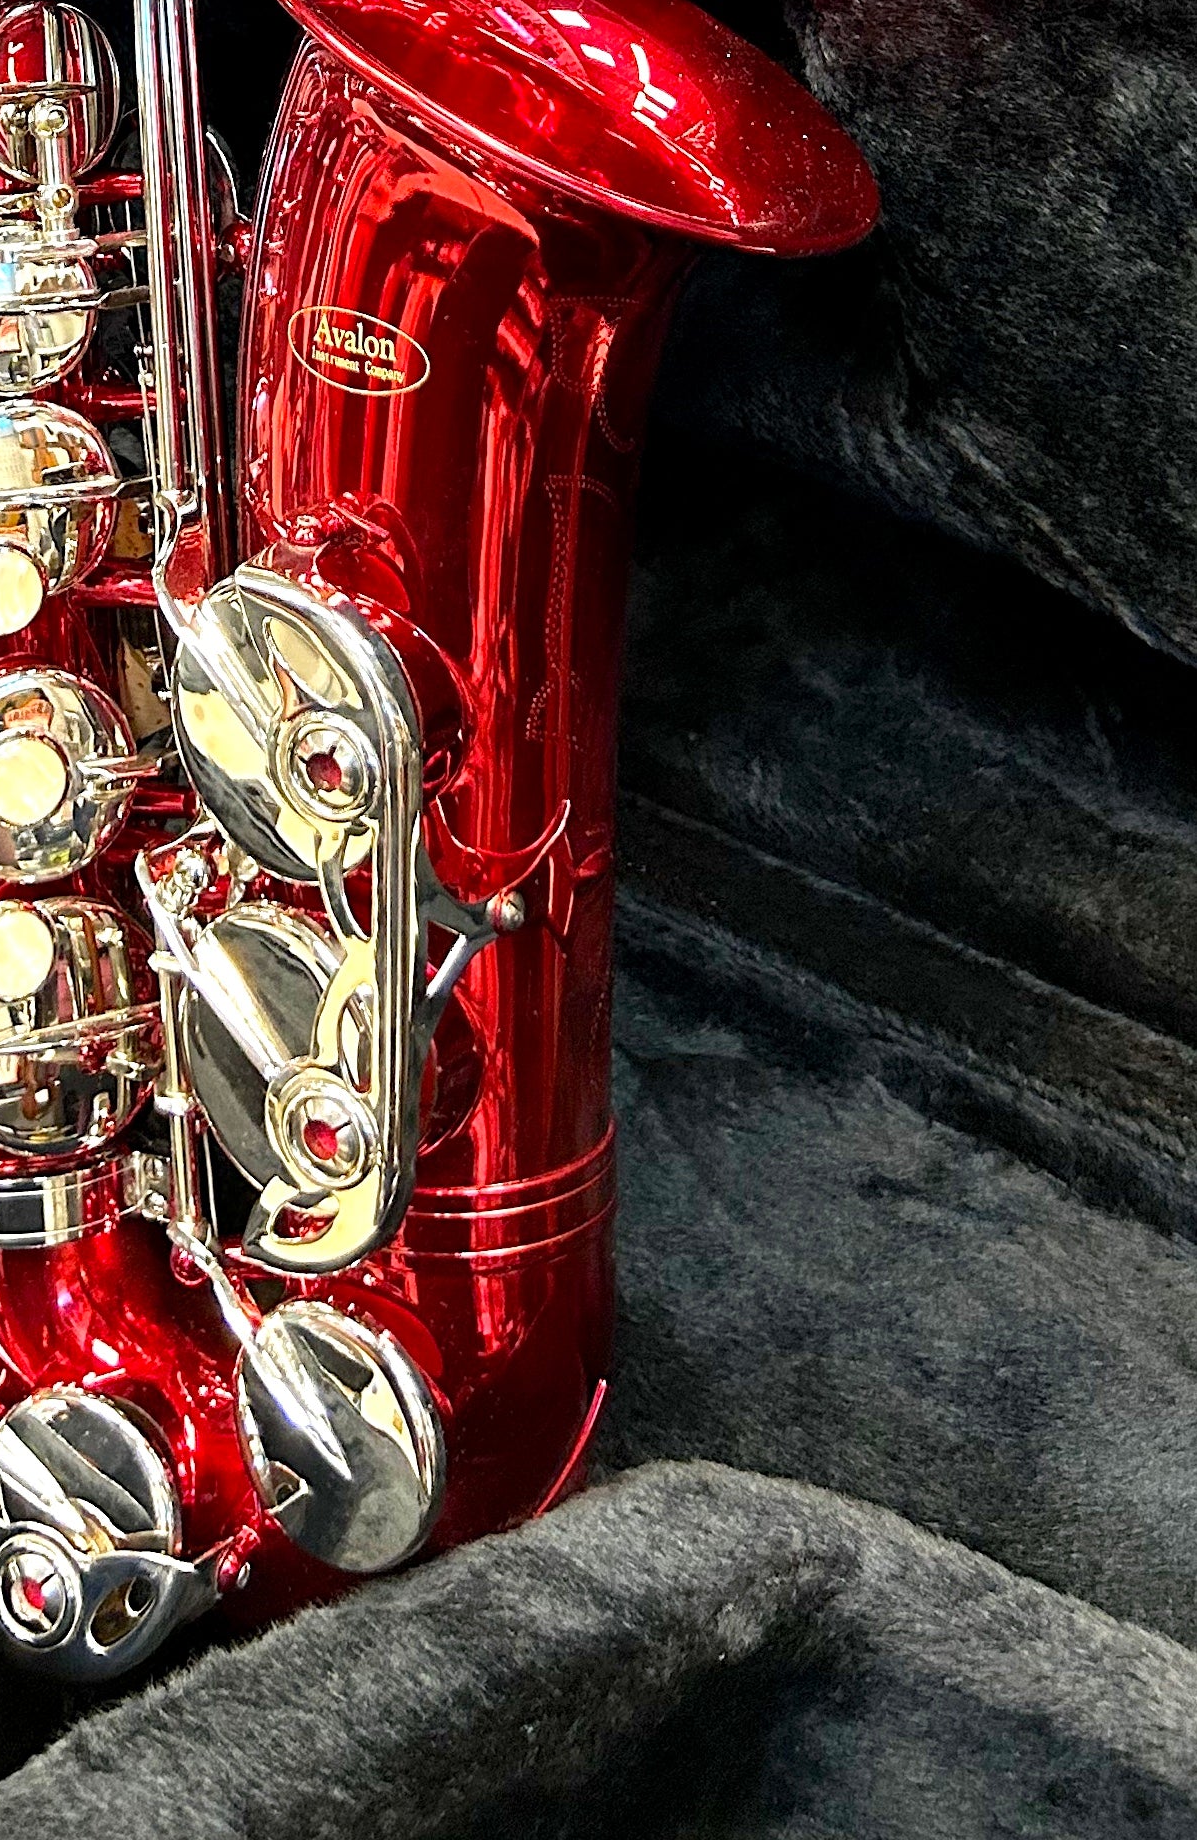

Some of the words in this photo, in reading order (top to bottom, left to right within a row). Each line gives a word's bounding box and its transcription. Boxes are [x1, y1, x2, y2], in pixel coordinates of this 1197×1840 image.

[313, 314, 396, 361] Avalon
[311, 345, 360, 372] Instrument
[364, 359, 405, 383] Company
